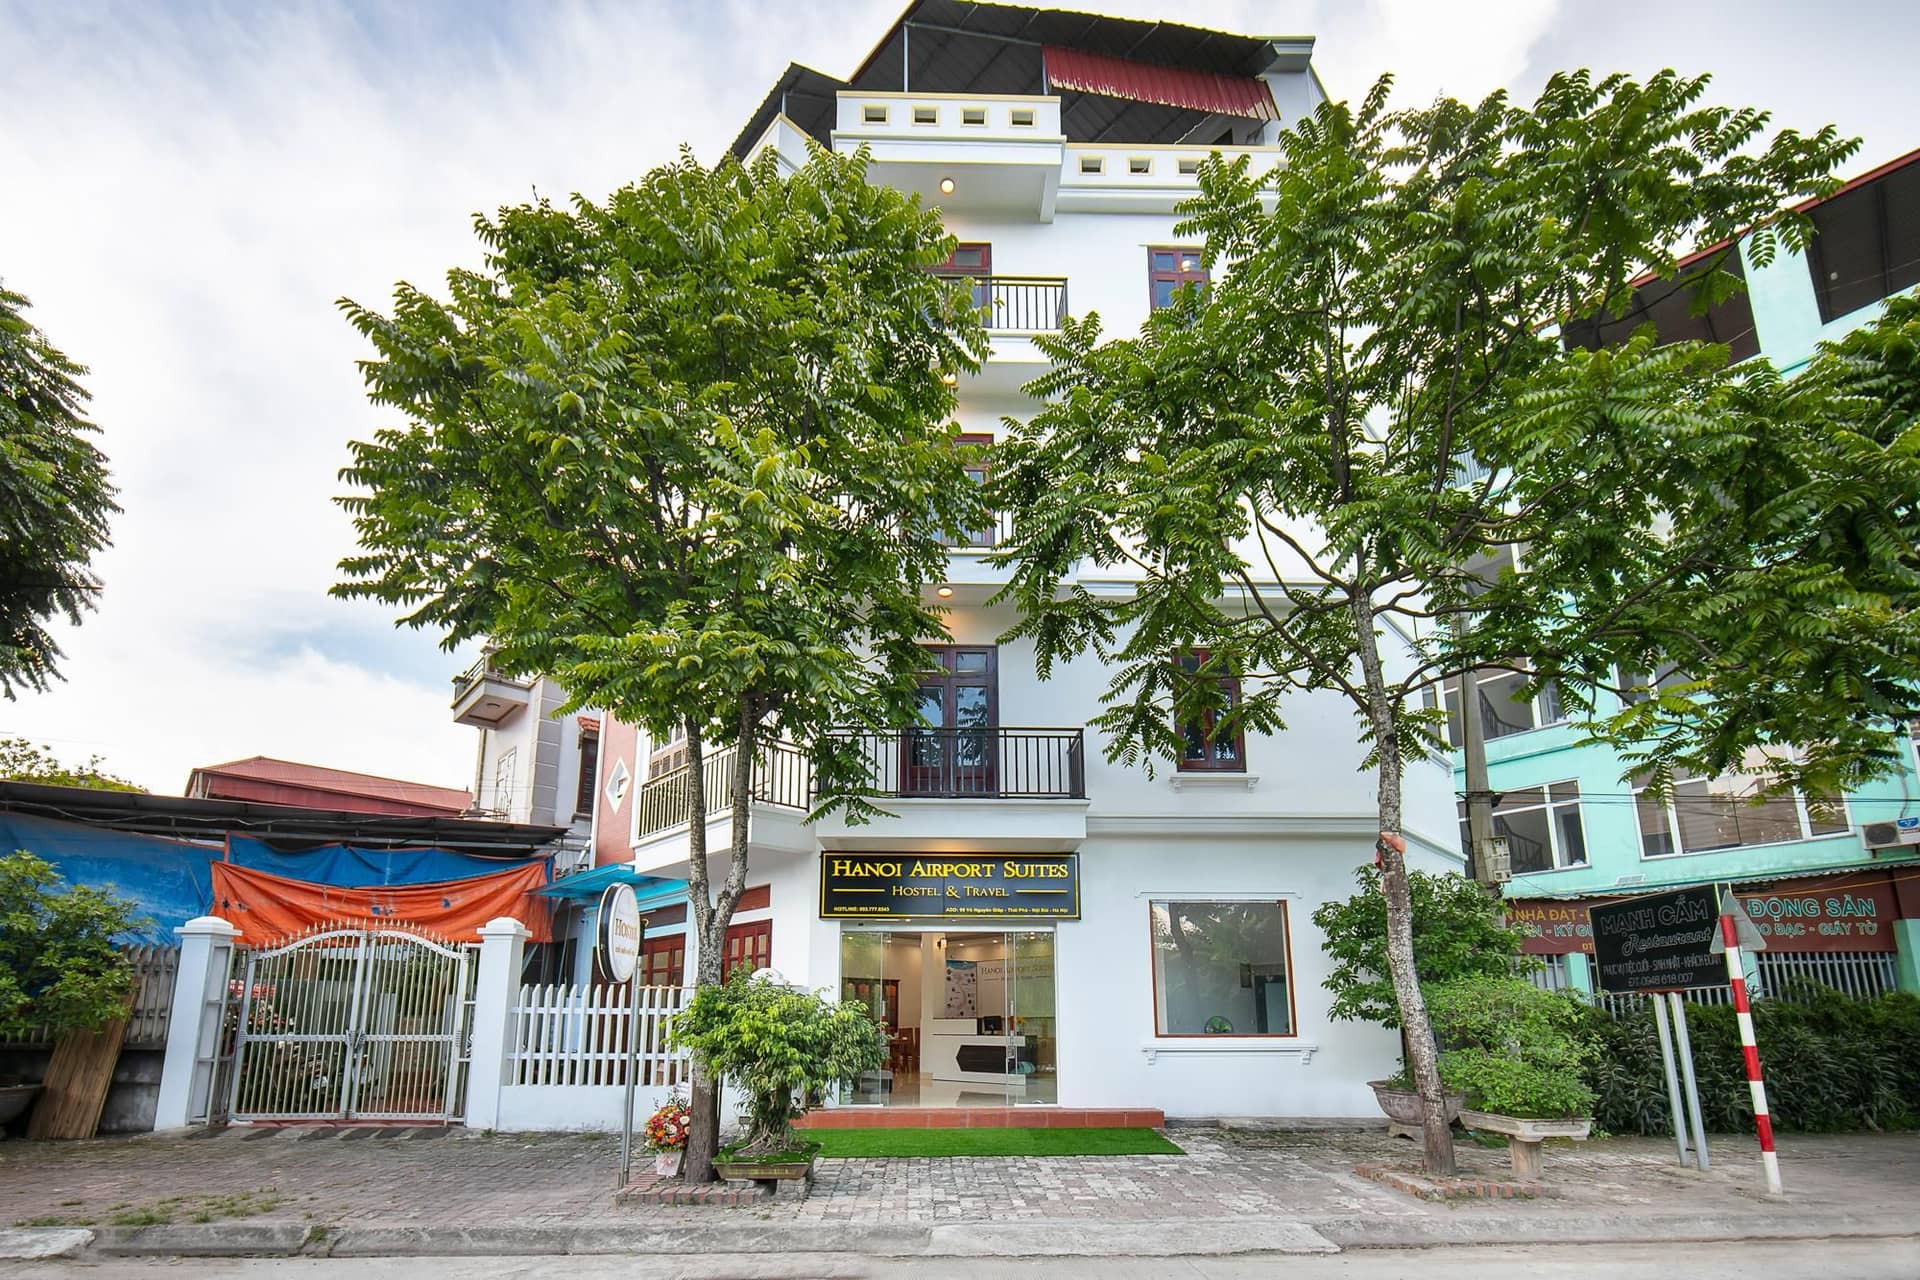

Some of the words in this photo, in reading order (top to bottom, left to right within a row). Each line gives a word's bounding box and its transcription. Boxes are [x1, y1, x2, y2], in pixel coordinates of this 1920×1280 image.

[832, 860, 902, 877] HANOI
[909, 860, 995, 878] AIRPORT
[1003, 861, 1069, 878] SUITES
[892, 885, 942, 896] HOSTEL
[945, 885, 960, 898] &
[963, 886, 1010, 897] TRAVEL
[1621, 926, 1712, 956] Restaurant
